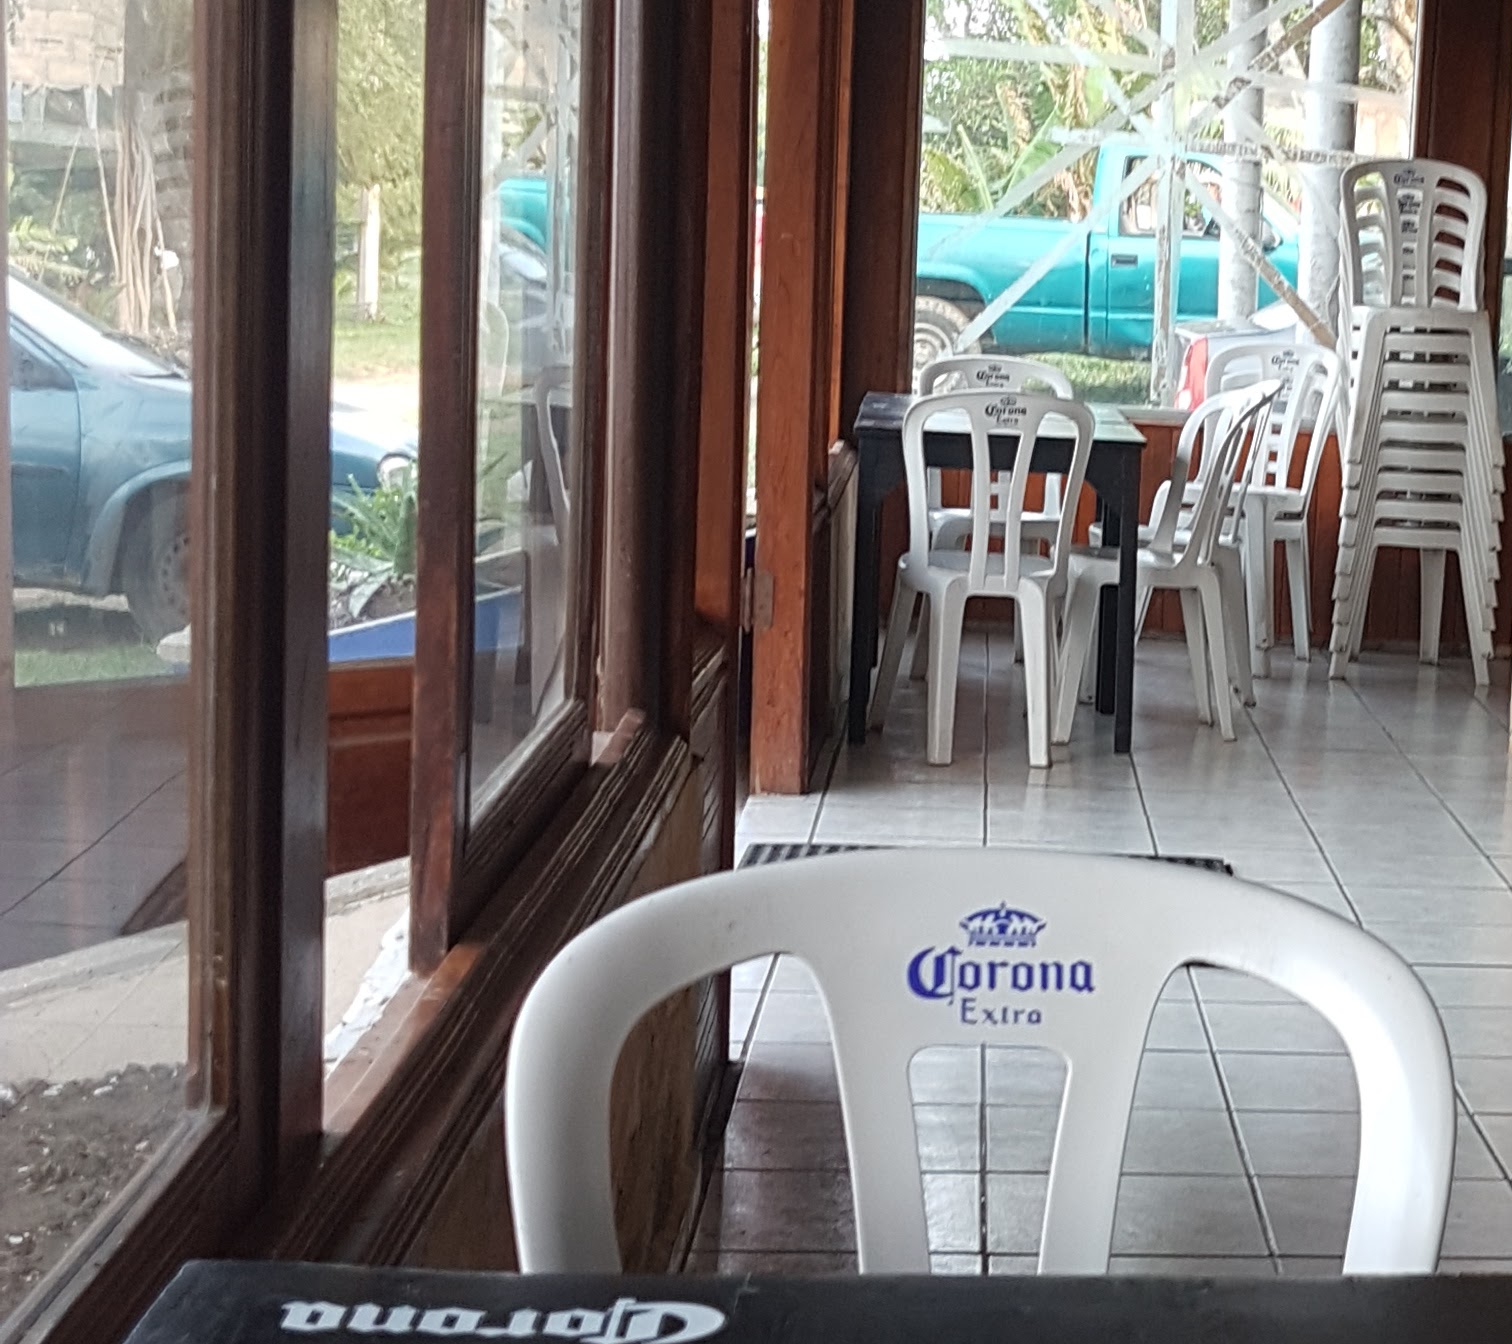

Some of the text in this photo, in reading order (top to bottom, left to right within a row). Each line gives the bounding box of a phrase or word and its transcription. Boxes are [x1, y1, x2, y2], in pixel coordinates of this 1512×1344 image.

[985, 403, 1027, 418] Corona
[907, 946, 1096, 1006] Corona
[960, 996, 1043, 1025] Extra
